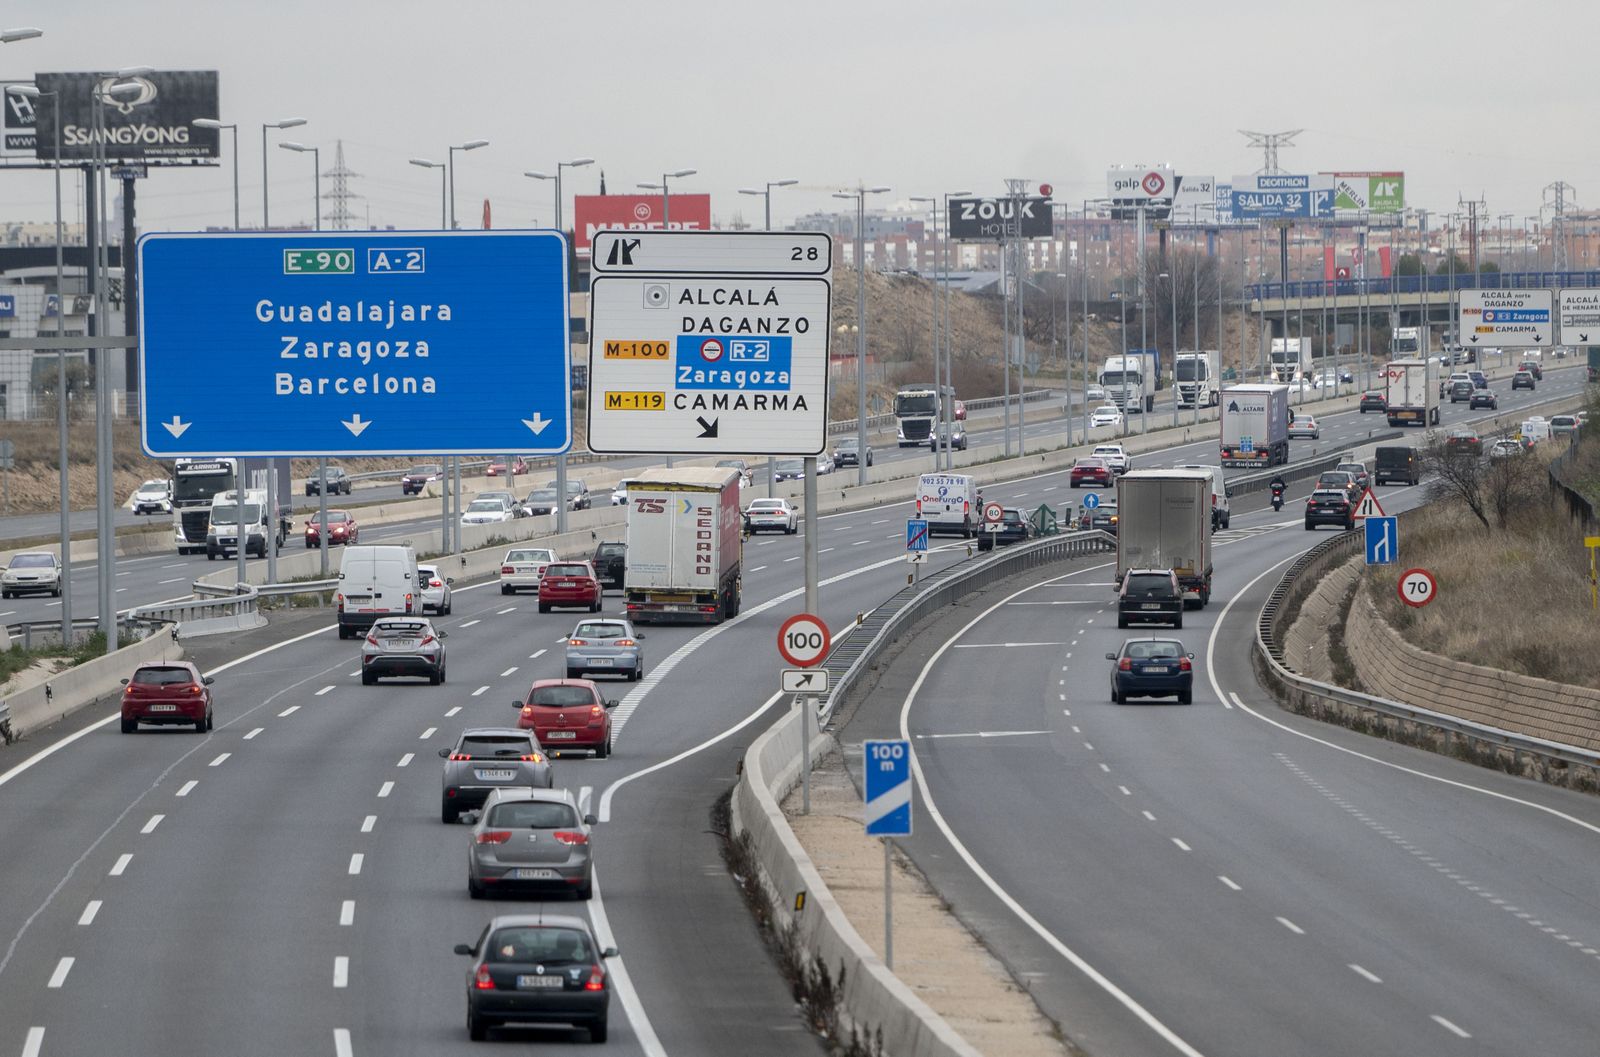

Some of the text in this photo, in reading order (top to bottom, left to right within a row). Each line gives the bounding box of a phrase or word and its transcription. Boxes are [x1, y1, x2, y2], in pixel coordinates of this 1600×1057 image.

[1114, 178, 1140, 191] galp
[1200, 183, 1210, 193] 32
[1260, 178, 1306, 187] DECATHLON
[1238, 194, 1301, 206] SALIDA 32
[1339, 180, 1367, 208] MERLIN
[961, 201, 1035, 219] ZOUK
[287, 252, 351, 271] E-90
[374, 252, 421, 270] A-2
[791, 247, 818, 261] 28
[678, 287, 779, 306] ALCALÁ
[1566, 295, 1599, 303] ALCALÁ
[255, 300, 452, 329] Guadalajara
[1513, 313, 1548, 321] Zaragoza
[682, 317, 809, 333] DAGANZO
[280, 336, 429, 365] Zaragoza
[606, 343, 667, 356] M-100
[733, 343, 766, 359] R-2
[275, 373, 436, 395] Barcelona
[678, 366, 789, 388] Zaragoza
[608, 394, 662, 407] M-119
[674, 394, 808, 411] CAMARMA
[988, 509, 999, 517] 80
[696, 506, 712, 575] SEDANO
[1407, 581, 1428, 595] 70
[786, 632, 822, 649] 100
[872, 744, 904, 760] 100
[880, 760, 895, 771] m
